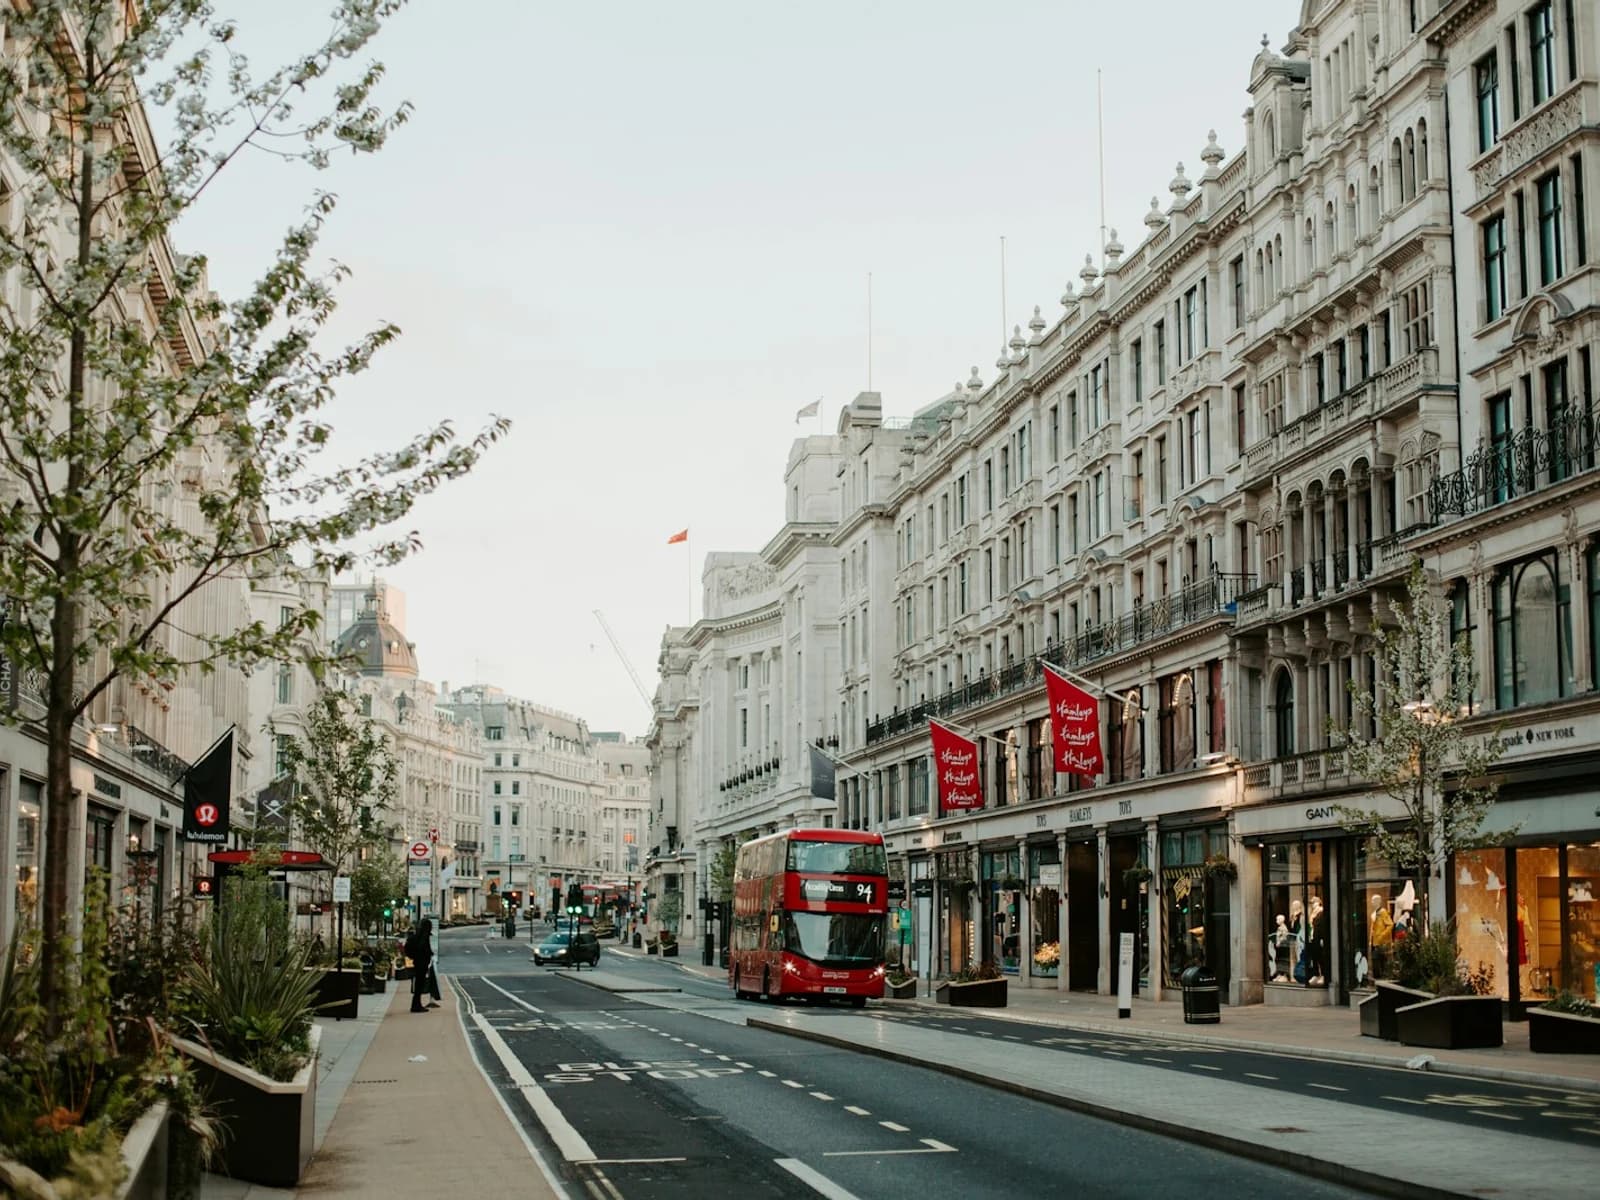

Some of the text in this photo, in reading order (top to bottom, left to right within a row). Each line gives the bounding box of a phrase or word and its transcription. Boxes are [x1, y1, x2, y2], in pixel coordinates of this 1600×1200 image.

[1056, 699, 1093, 722] Hamleys
[1536, 730, 1552, 742] NEW
[1554, 726, 1575, 740] YORK
[941, 747, 973, 766] Hamleys
[1069, 806, 1092, 823] HAMLEYS
[1119, 800, 1132, 816] TOYS
[1305, 806, 1335, 820] GANT
[186, 829, 225, 840] lululemon
[857, 884, 872, 900] 94
[556, 1060, 700, 1072] BUS
[543, 1068, 744, 1083] STOP
